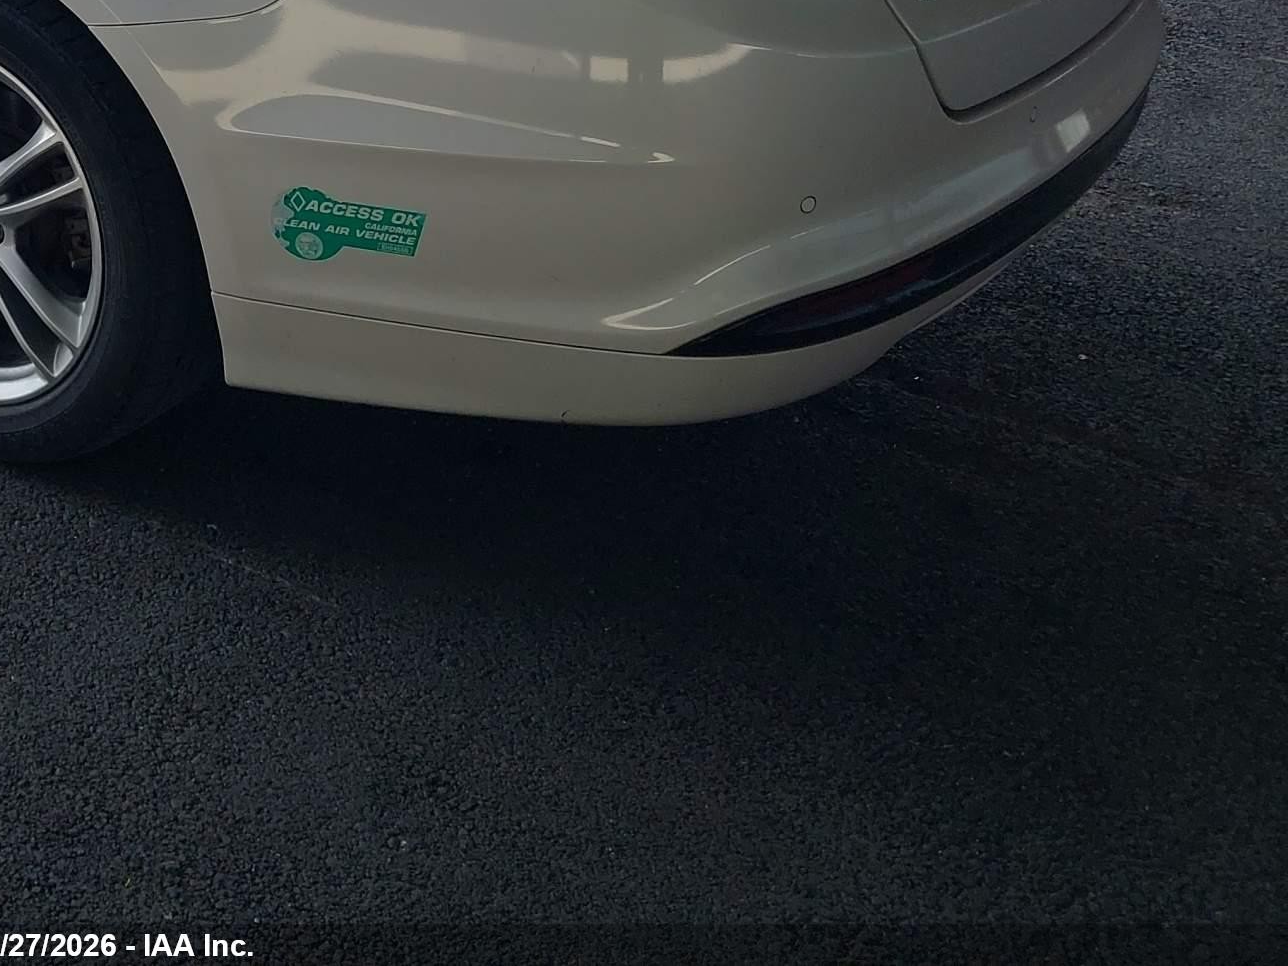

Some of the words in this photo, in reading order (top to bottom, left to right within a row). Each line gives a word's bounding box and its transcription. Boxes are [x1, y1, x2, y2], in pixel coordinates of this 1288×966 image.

[305, 200, 384, 221] ACCESS
[391, 212, 422, 227] OK
[325, 224, 350, 235] AIR
[355, 229, 417, 245] VEHICLE
[364, 222, 418, 236] CALIFORNIA
